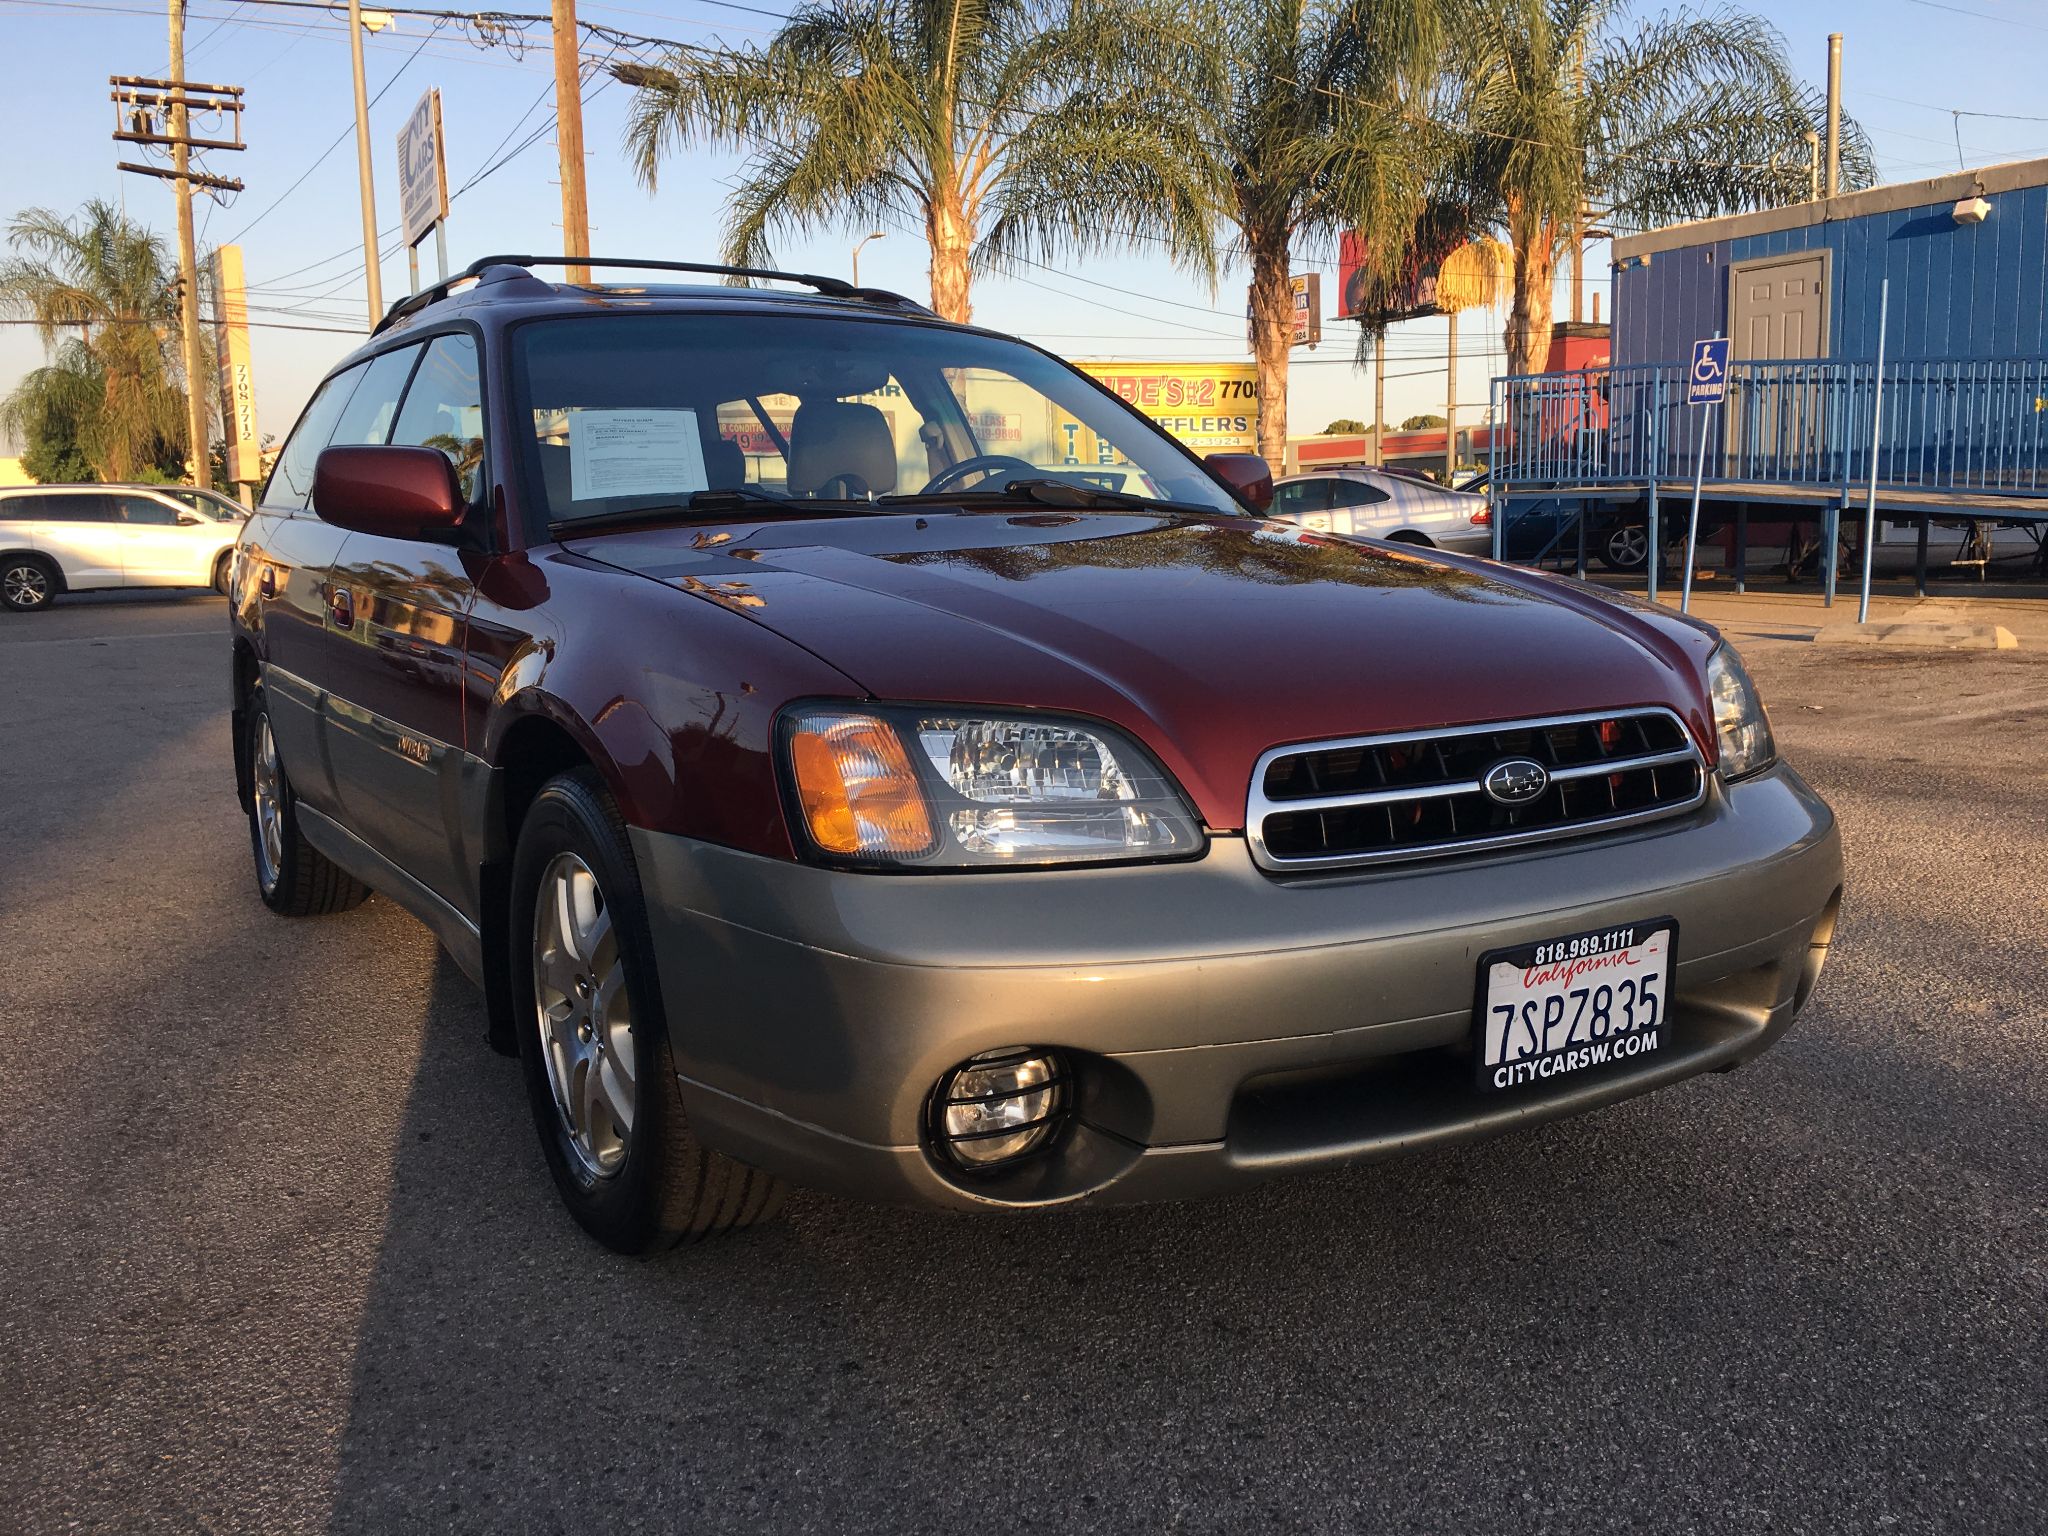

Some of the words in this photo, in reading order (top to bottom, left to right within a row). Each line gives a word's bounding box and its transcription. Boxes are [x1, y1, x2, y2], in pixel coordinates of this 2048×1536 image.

[1691, 383, 1722, 396] PARKING
[980, 415, 1007, 427] LEASE
[1157, 416, 1247, 432] FFLERS
[1182, 437, 1241, 446] 2-3924
[1535, 927, 1634, 965] 818.989.1111
[1523, 950, 1641, 990] California
[1492, 973, 1659, 1065] 7SPZ835
[1493, 1031, 1658, 1089] CITYCARSW.COM
